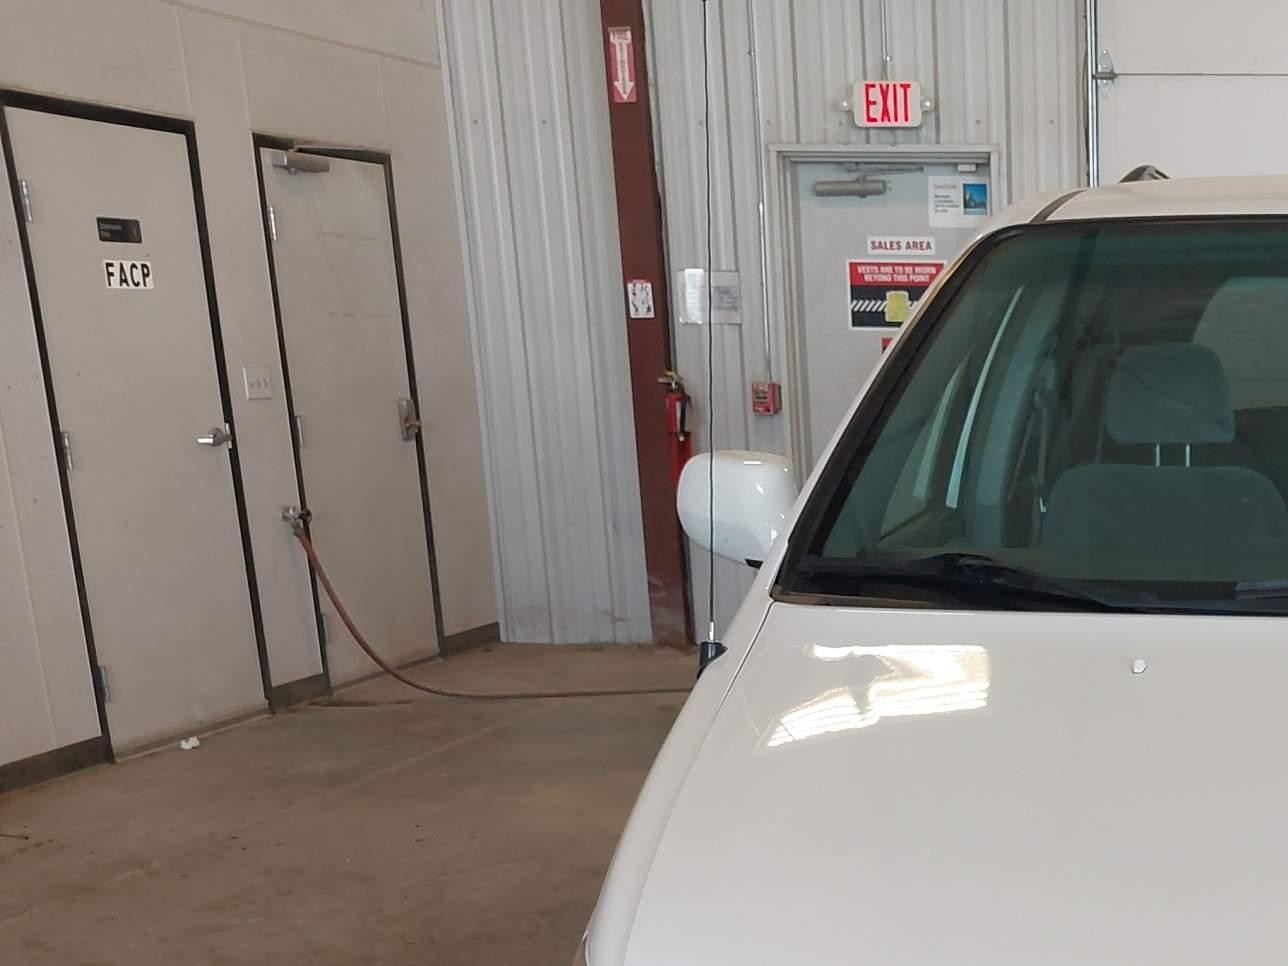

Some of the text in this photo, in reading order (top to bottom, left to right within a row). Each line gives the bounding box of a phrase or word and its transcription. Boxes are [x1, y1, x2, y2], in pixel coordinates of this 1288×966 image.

[864, 82, 911, 123] EXIT
[871, 240, 932, 251] SALES AREA
[105, 261, 150, 287] FACP
